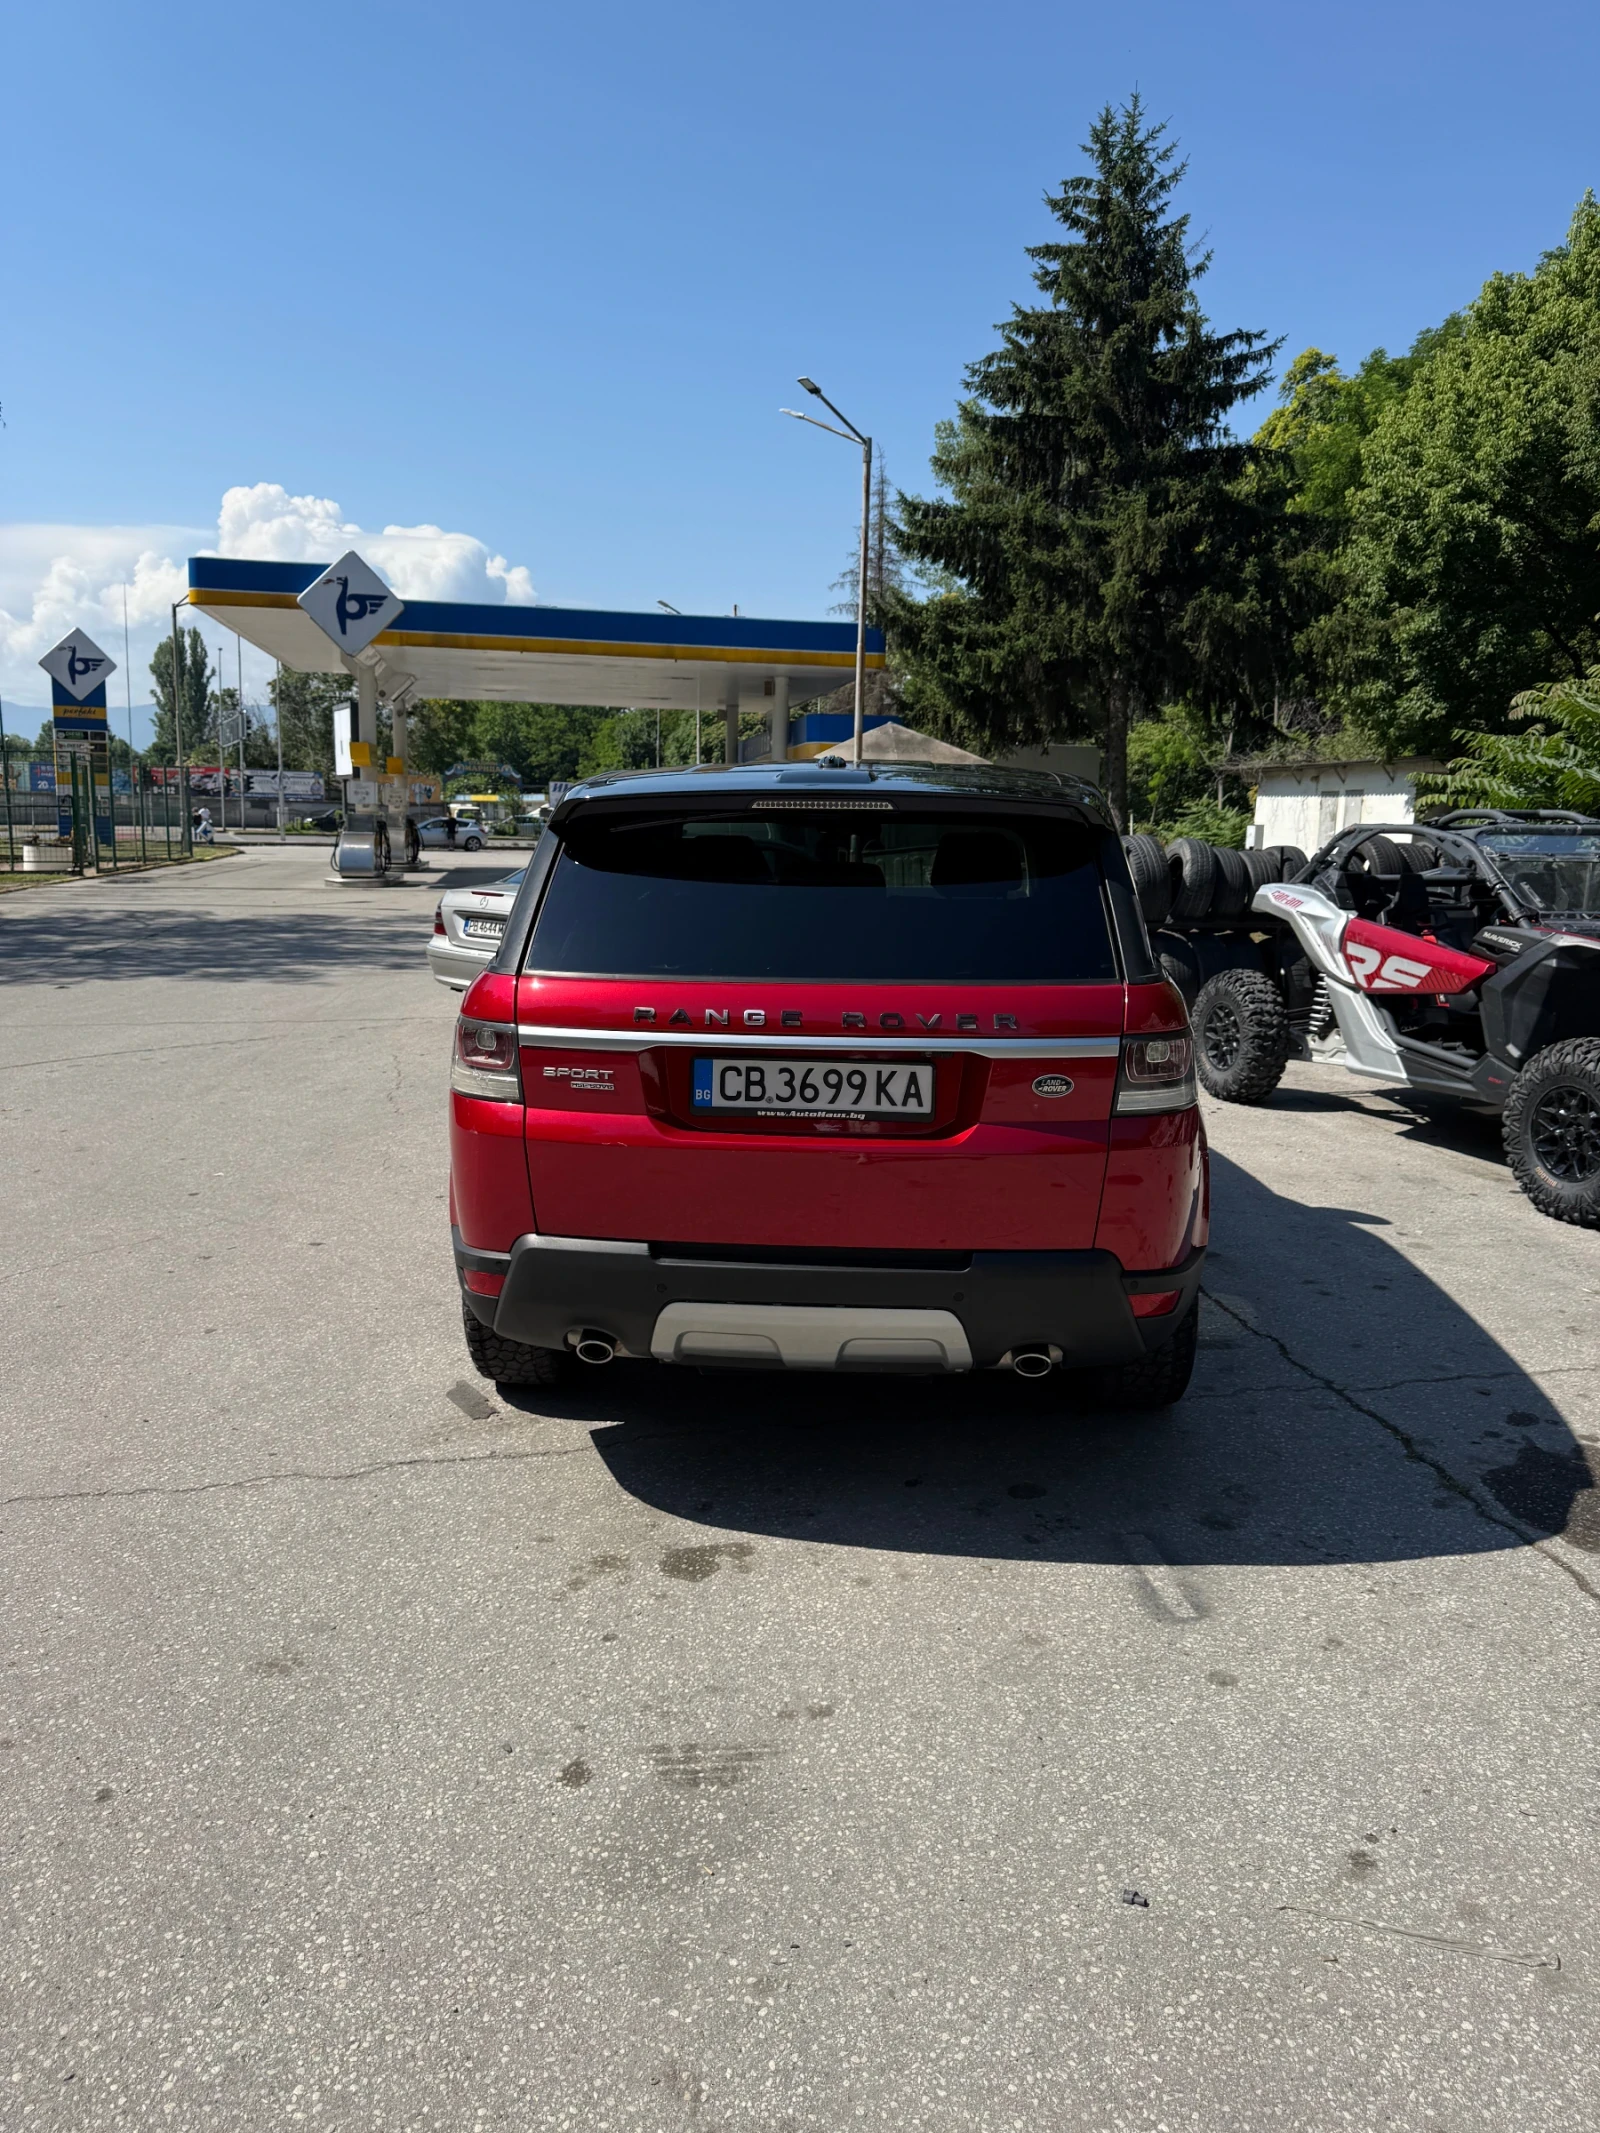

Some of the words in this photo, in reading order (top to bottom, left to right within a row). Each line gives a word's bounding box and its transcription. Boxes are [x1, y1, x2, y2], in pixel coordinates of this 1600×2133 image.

[1482, 931, 1523, 949] MAVERICK
[633, 1006, 804, 1027] RANGE
[841, 1011, 1019, 1030] ROVER
[543, 1066, 614, 1080] SPORT
[695, 1089, 711, 1100] BG
[757, 1109, 866, 1121] www.AutoHaus.bg
